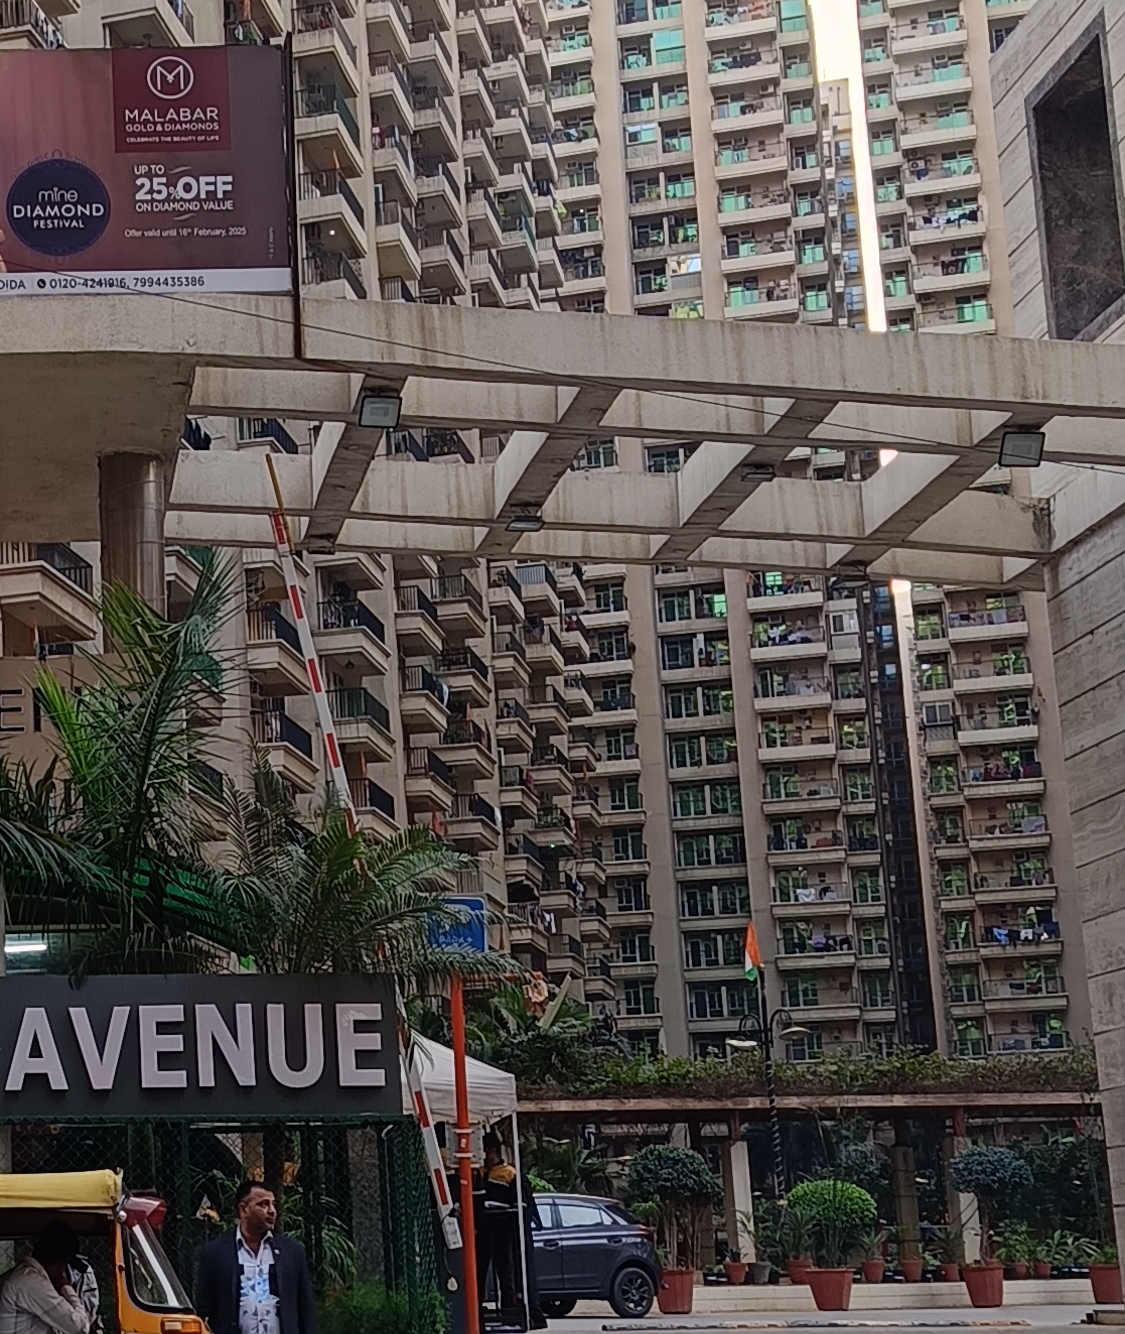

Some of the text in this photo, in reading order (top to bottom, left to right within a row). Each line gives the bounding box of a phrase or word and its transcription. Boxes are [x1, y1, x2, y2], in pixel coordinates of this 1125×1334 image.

[125, 107, 219, 122] MALABAR
[125, 122, 220, 132] GOLD & DIAMONDS
[133, 164, 165, 175] UP TO
[38, 186, 79, 203] mine
[13, 203, 105, 218] DIAMOND
[135, 200, 234, 212] ON DIAMOND VALUE
[33, 219, 85, 229] FESTIVAL
[124, 228, 143, 238] Offer
[143, 228, 161, 237] valid
[161, 228, 177, 237] until
[228, 226, 247, 236] 2025
[133, 276, 205, 288] 7994435386
[4, 1003, 386, 1092] AVENUE
